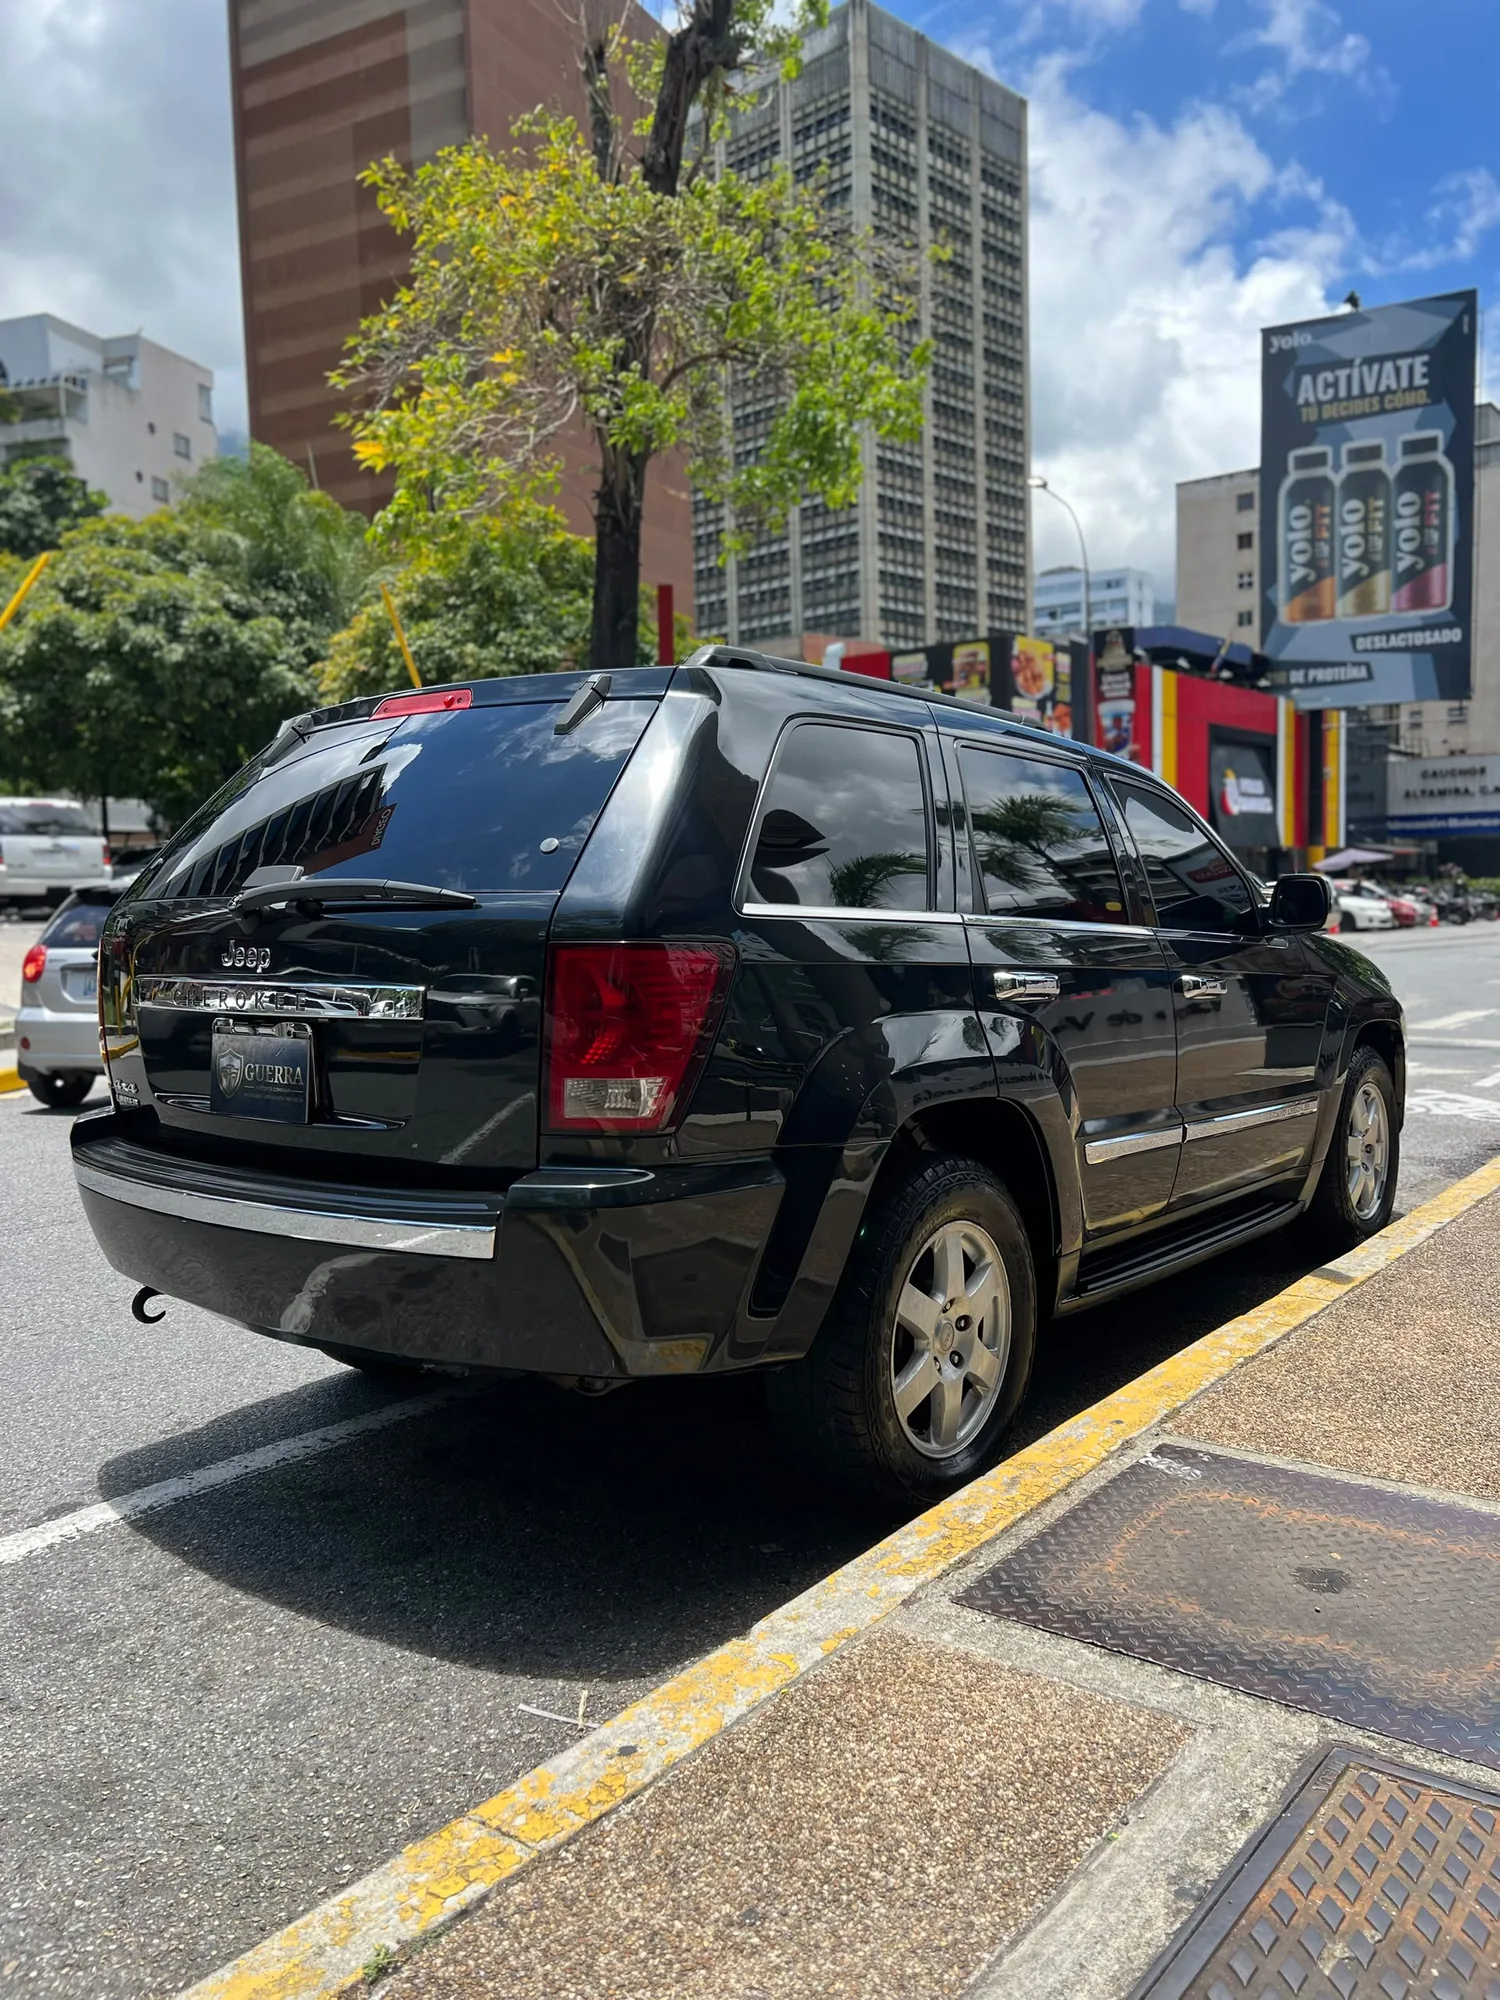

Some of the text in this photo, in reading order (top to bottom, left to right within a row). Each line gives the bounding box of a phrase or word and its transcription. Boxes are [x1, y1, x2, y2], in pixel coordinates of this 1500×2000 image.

[1297, 355, 1430, 405] ACTÍVATE
[1322, 396, 1380, 420] DECIDES
[1340, 498, 1370, 579] yolo
[1393, 491, 1425, 574] yolo
[1356, 627, 1463, 650] DESLACTOSADO
[1308, 662, 1369, 683] PROTEÍNA
[221, 940, 271, 973] Jeep
[172, 988, 306, 1012] CHEROKEE
[244, 1063, 304, 1086] GUERRA
